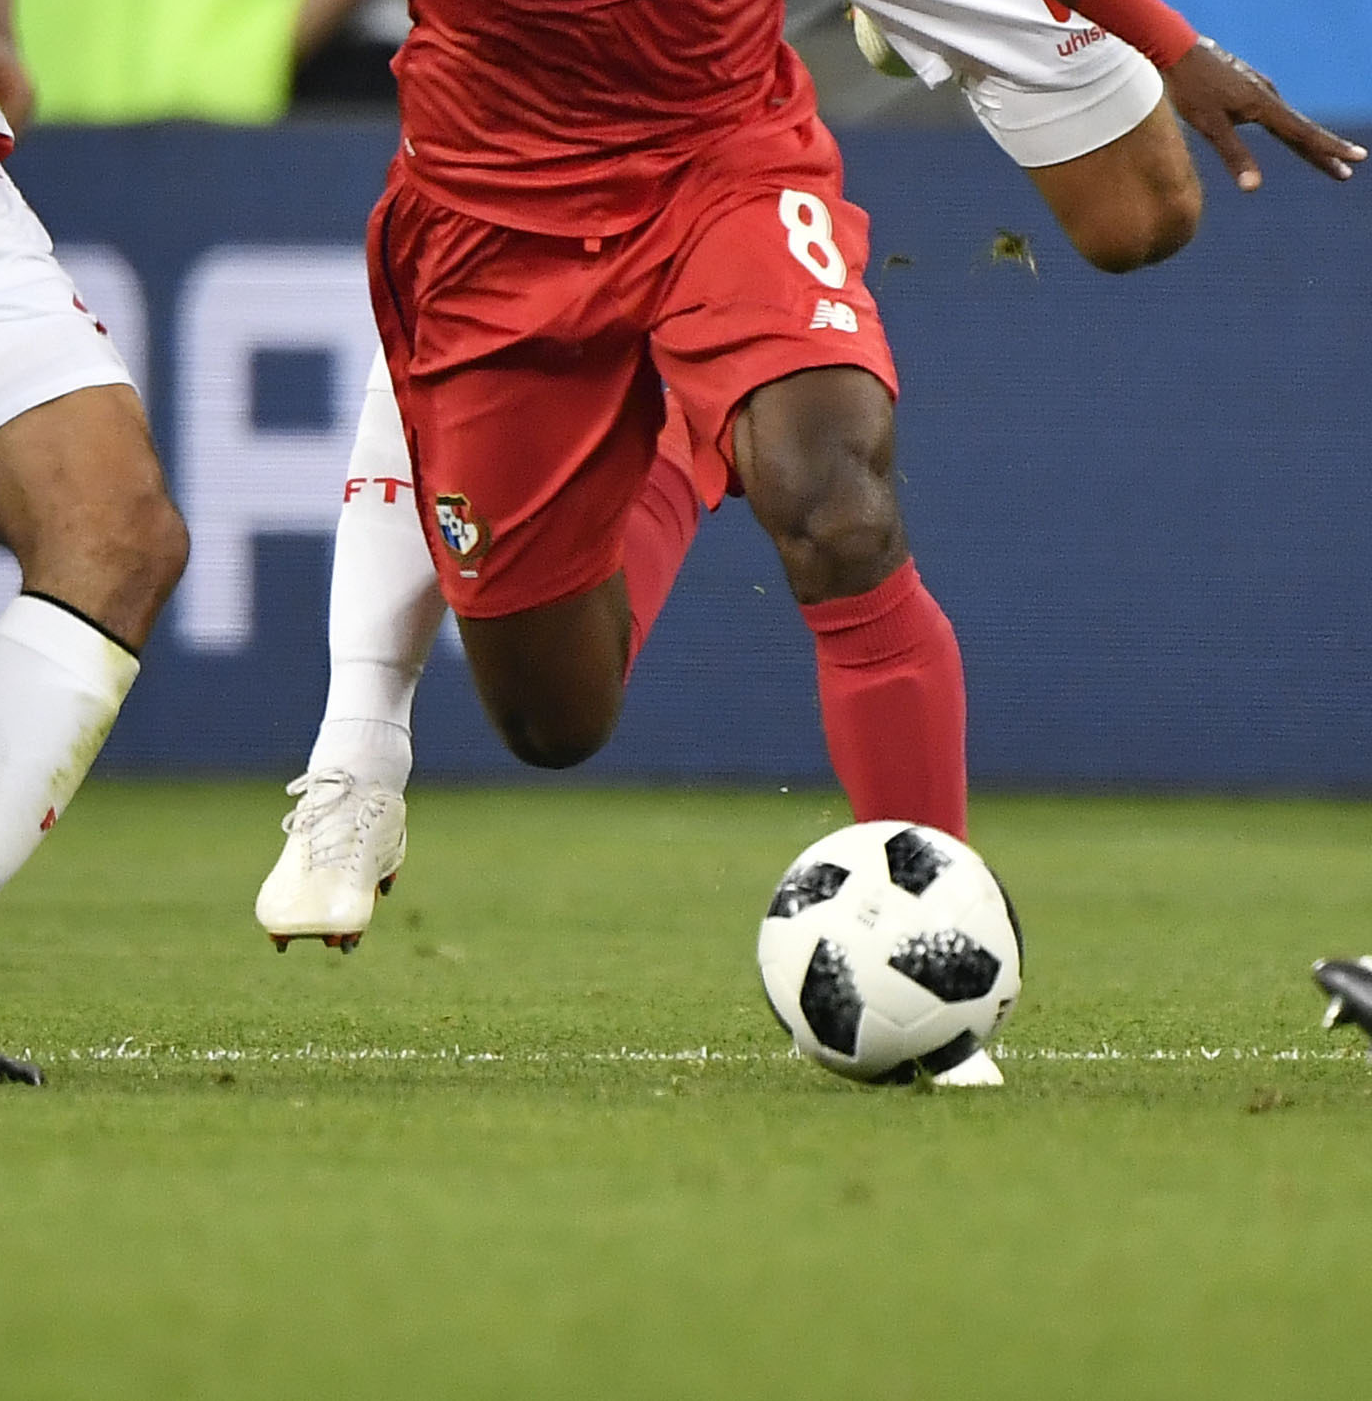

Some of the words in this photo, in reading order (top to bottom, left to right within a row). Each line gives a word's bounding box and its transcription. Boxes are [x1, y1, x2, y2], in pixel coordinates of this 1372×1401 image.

[1056, 24, 1108, 57] uhls
[779, 188, 847, 289] 8
[343, 477, 413, 504] FT
